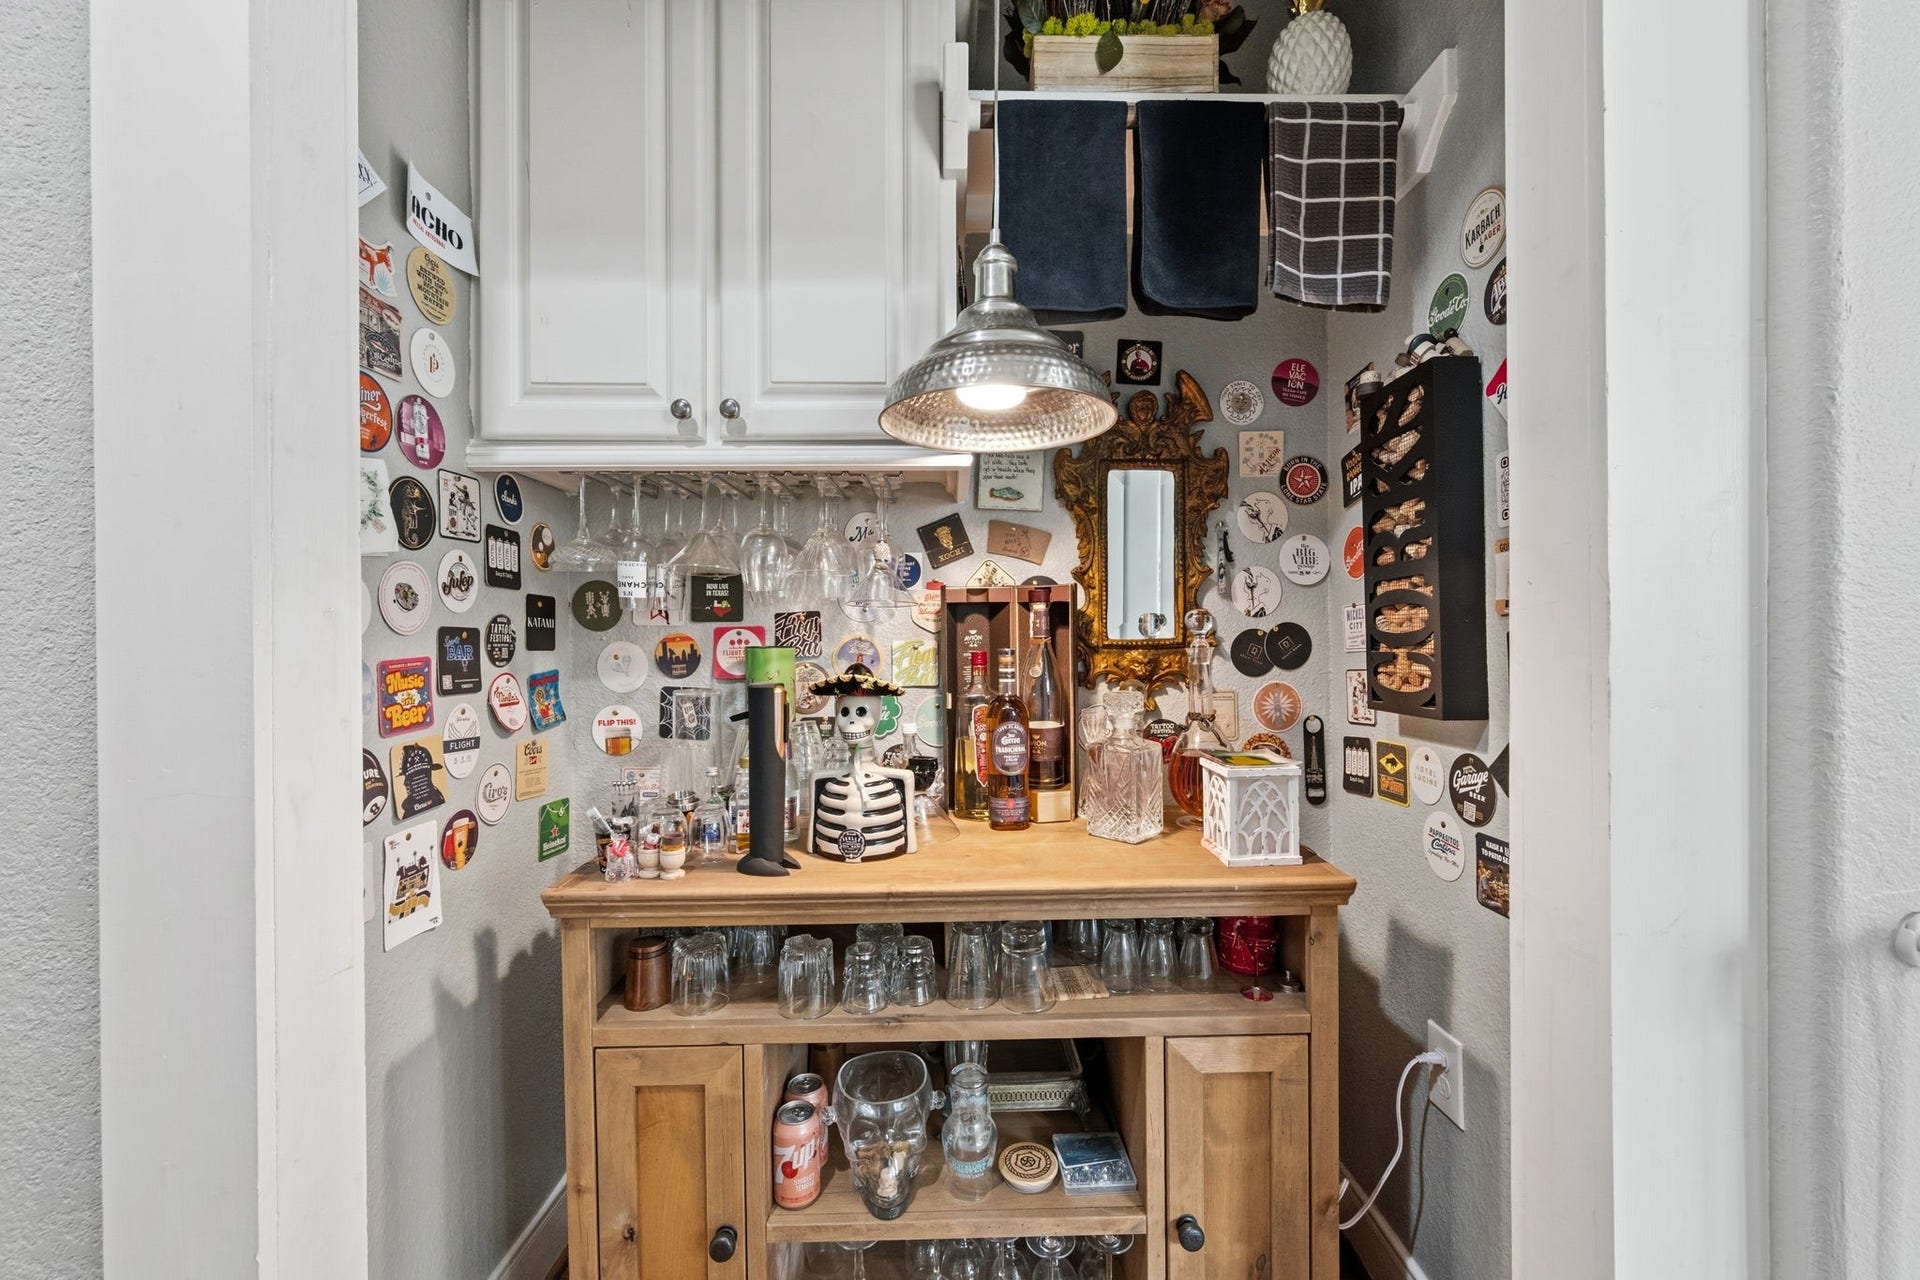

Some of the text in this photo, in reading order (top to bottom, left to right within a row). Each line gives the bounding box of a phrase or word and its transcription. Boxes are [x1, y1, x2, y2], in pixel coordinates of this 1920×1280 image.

[1465, 203, 1501, 250] KARBACH
[1480, 224, 1502, 245] LAGER
[1291, 362, 1306, 373] ELE
[1289, 370, 1307, 381] VAC
[1310, 458, 1322, 470] THE
[1349, 473, 1363, 496] IPA
[1296, 547, 1316, 557] BIG
[1292, 554, 1319, 565] VIBE
[441, 570, 474, 595] Julep
[1349, 621, 1363, 630] CITY
[489, 633, 512, 643] FESTIVAL
[447, 645, 473, 660] BAR
[385, 671, 425, 695] Music
[385, 704, 427, 729] Beer
[598, 718, 636, 727] FLIP THIS!
[450, 740, 475, 750] FLIGHT
[524, 743, 543, 756] Coors
[1453, 769, 1489, 793] Garage
[370, 802, 380, 815] 8
[542, 836, 567, 851] Heineken
[1481, 847, 1489, 856] TO
